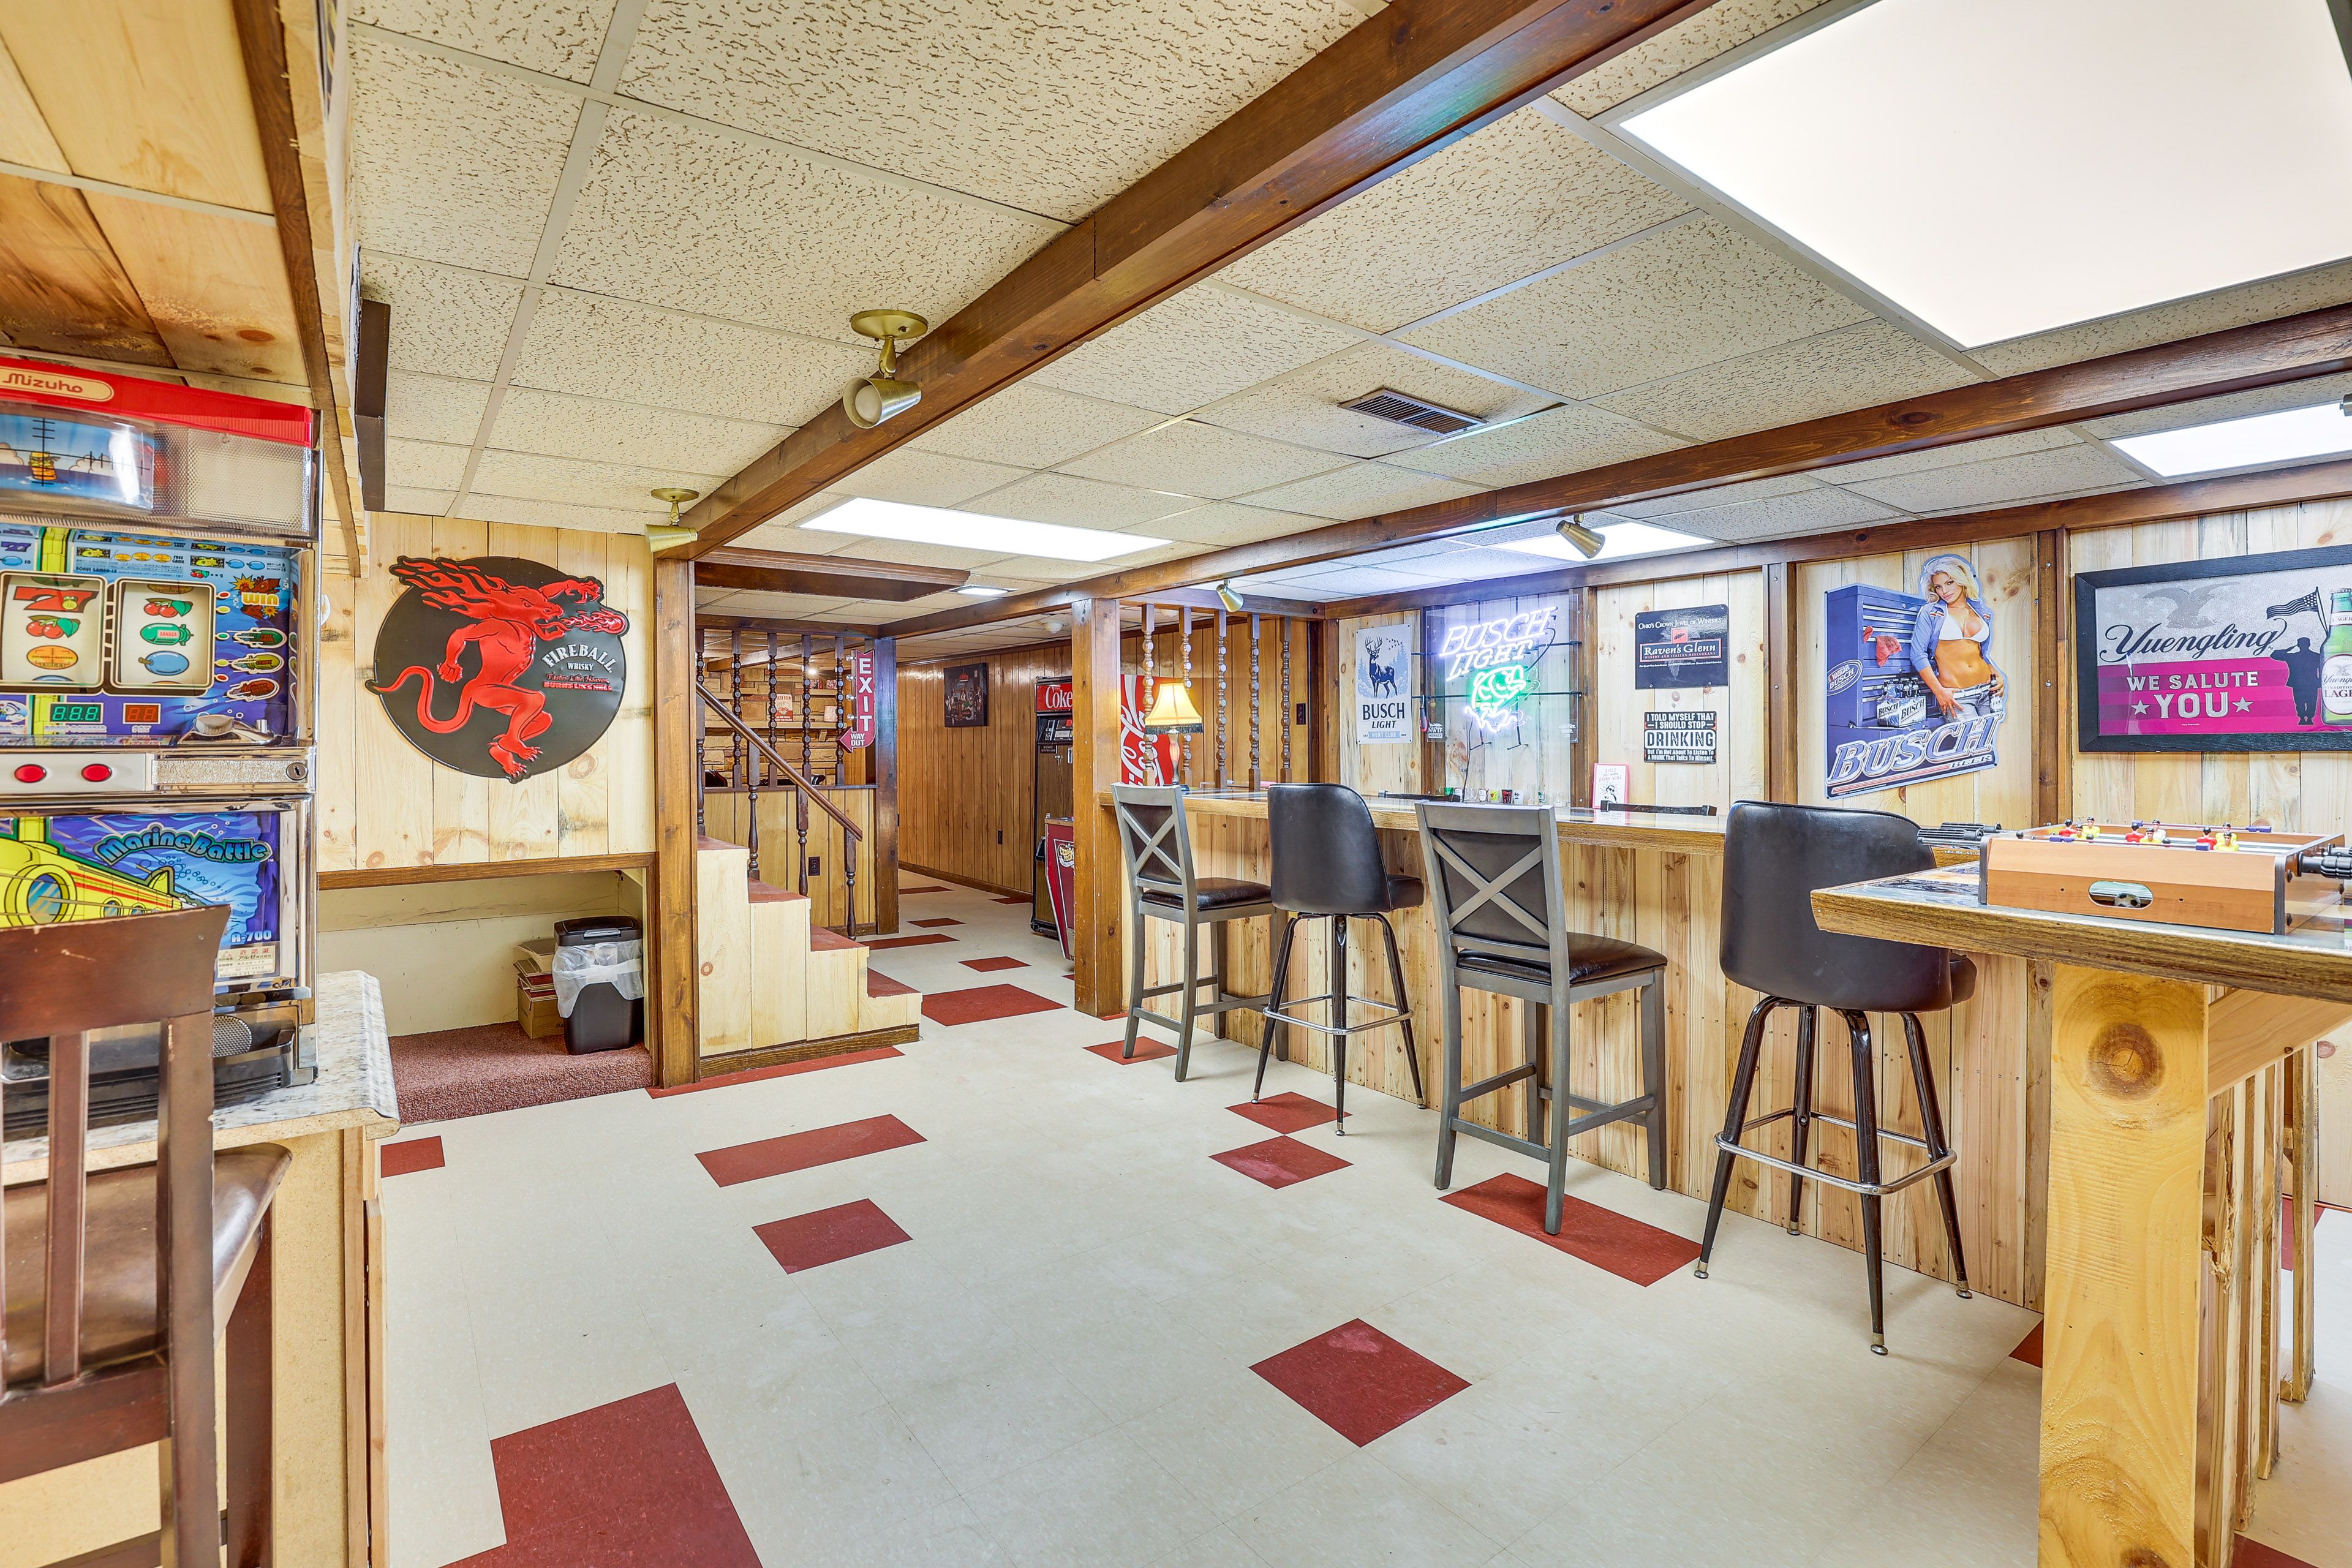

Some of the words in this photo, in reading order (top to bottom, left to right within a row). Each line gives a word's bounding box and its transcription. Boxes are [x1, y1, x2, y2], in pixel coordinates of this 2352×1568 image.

[2, 373, 83, 393] Mizuho
[241, 592, 279, 606] WIN
[1439, 606, 1558, 657] BUSCH
[2100, 617, 2287, 663] Yuengling
[542, 644, 616, 672] FIREBALL
[1645, 644, 1681, 655] Raven's
[1684, 642, 1716, 653] Glenn
[567, 662, 594, 671] WHISKY
[1446, 639, 1534, 682] LIGHT
[1829, 667, 1855, 690] BUSCH
[1831, 665, 1851, 680] NASCAR
[2126, 675, 2160, 692] WE
[2169, 671, 2259, 690] SALUTE
[859, 658, 873, 732] EXIT
[1045, 685, 1072, 709] Coke
[2154, 692, 2228, 719] YOU
[1362, 702, 1405, 720] BUSCH
[1879, 703, 1899, 715] BUSCH
[1901, 699, 1925, 720] BUSCH
[1647, 732, 1714, 746] DRINKING
[1827, 712, 2003, 785] BUSCH
[1950, 755, 1992, 768] BEER
[97, 826, 193, 862] Marine
[189, 835, 268, 862] Battle
[231, 930, 272, 943] A-700
